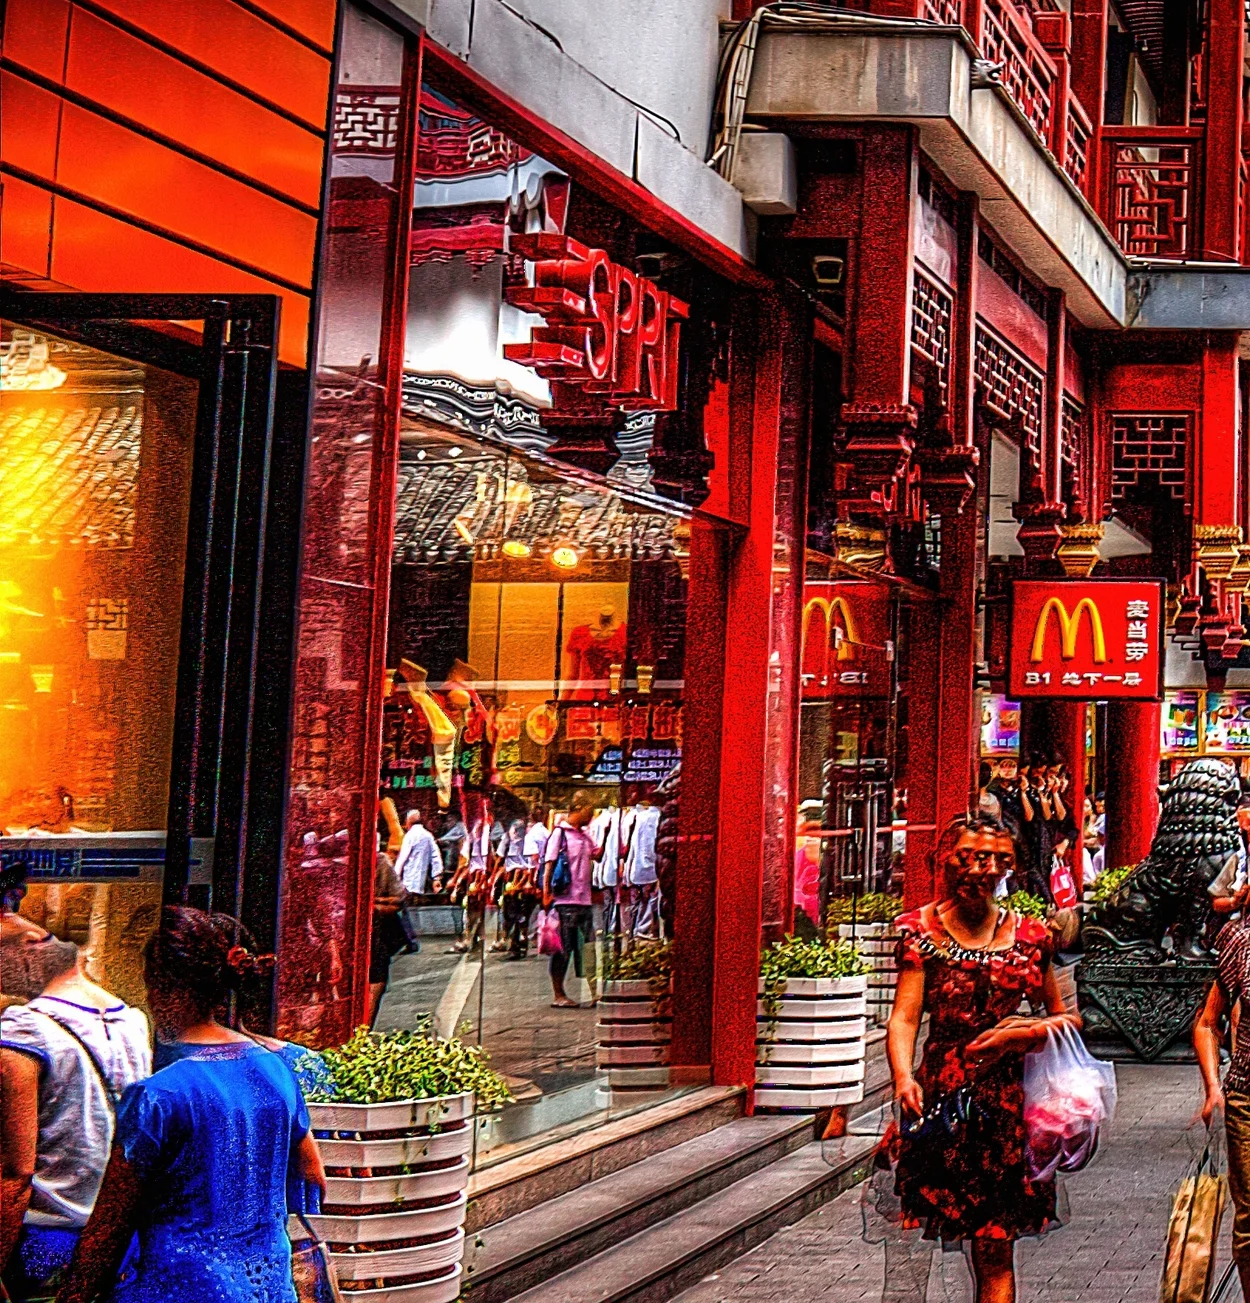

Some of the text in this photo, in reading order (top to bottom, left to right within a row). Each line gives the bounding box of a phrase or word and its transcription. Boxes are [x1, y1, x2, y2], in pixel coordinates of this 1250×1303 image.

[508, 232, 690, 409] ESPRIT
[1125, 599, 1149, 662] 麦当劳
[1025, 672, 1143, 686] B1 地下一层
